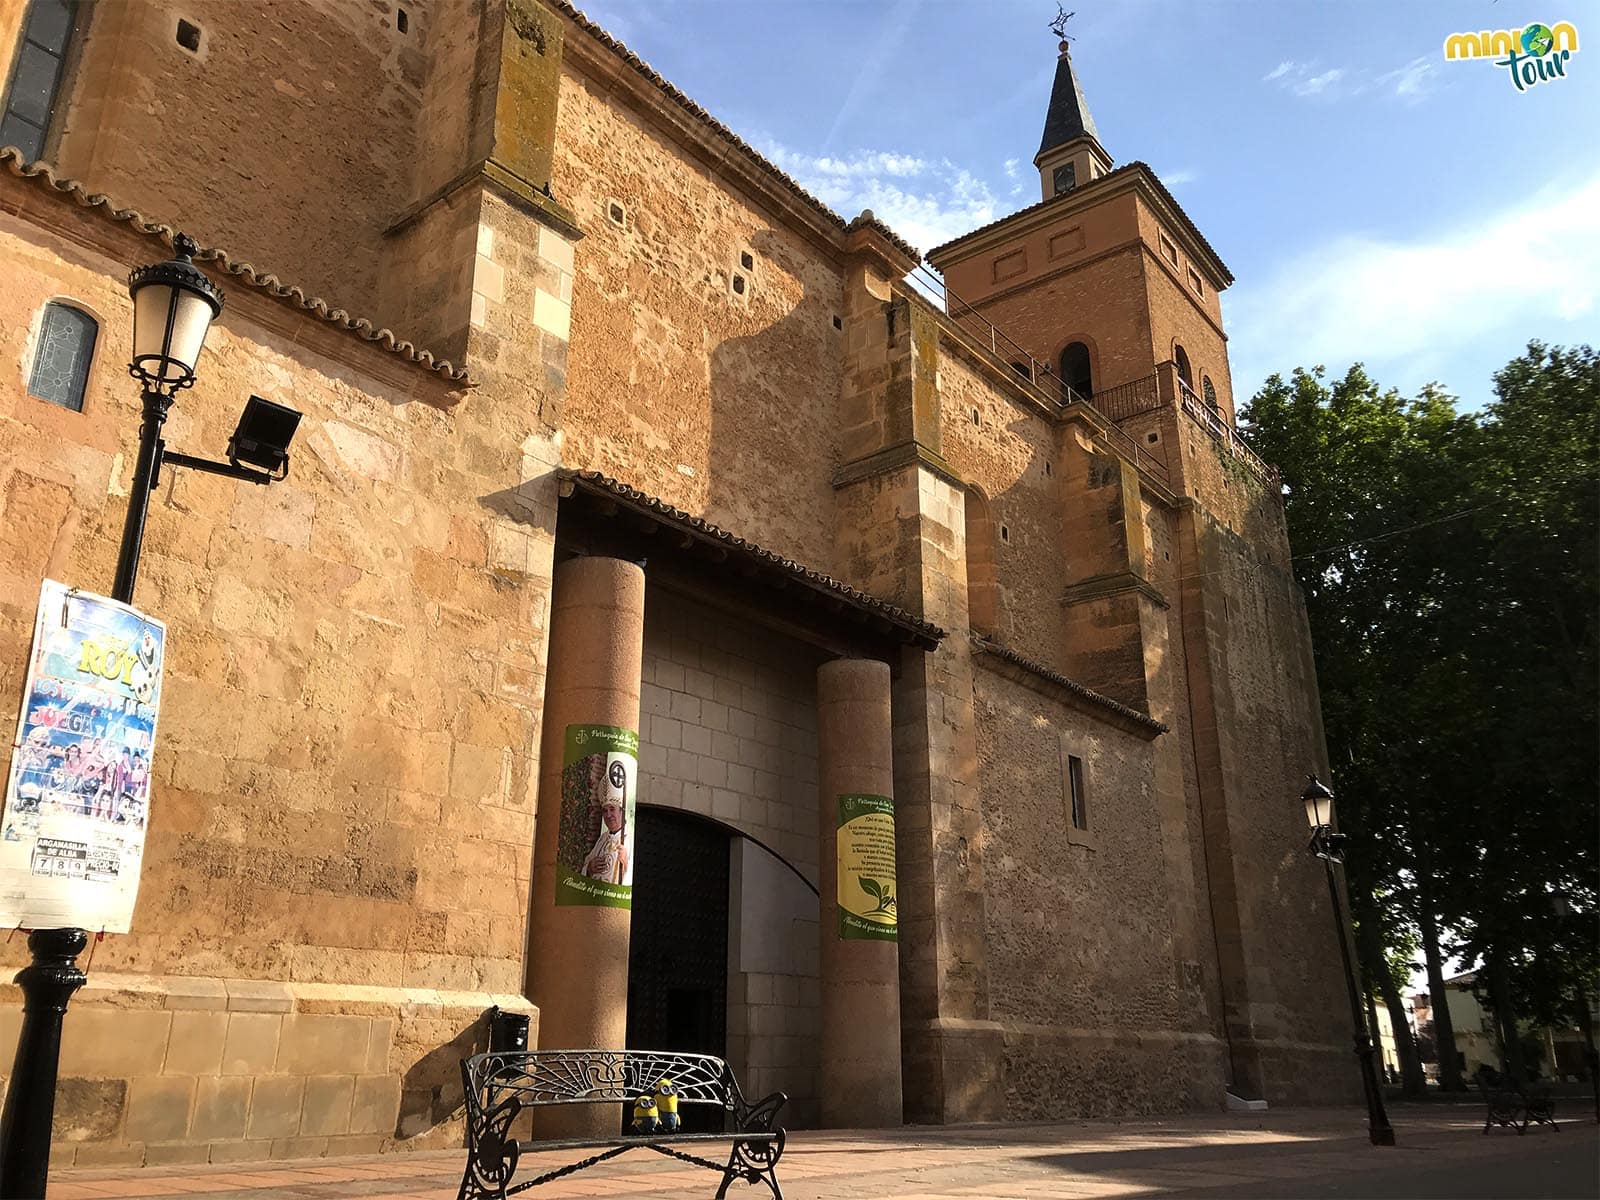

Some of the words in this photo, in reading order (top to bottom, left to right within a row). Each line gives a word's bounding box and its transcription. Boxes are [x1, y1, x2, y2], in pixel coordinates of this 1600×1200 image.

[77, 639, 139, 687] ROY
[37, 838, 88, 849] ARGAMASILLA
[41, 859, 47, 868] 7
[58, 860, 65, 869] 8
[75, 862, 81, 870] 9
